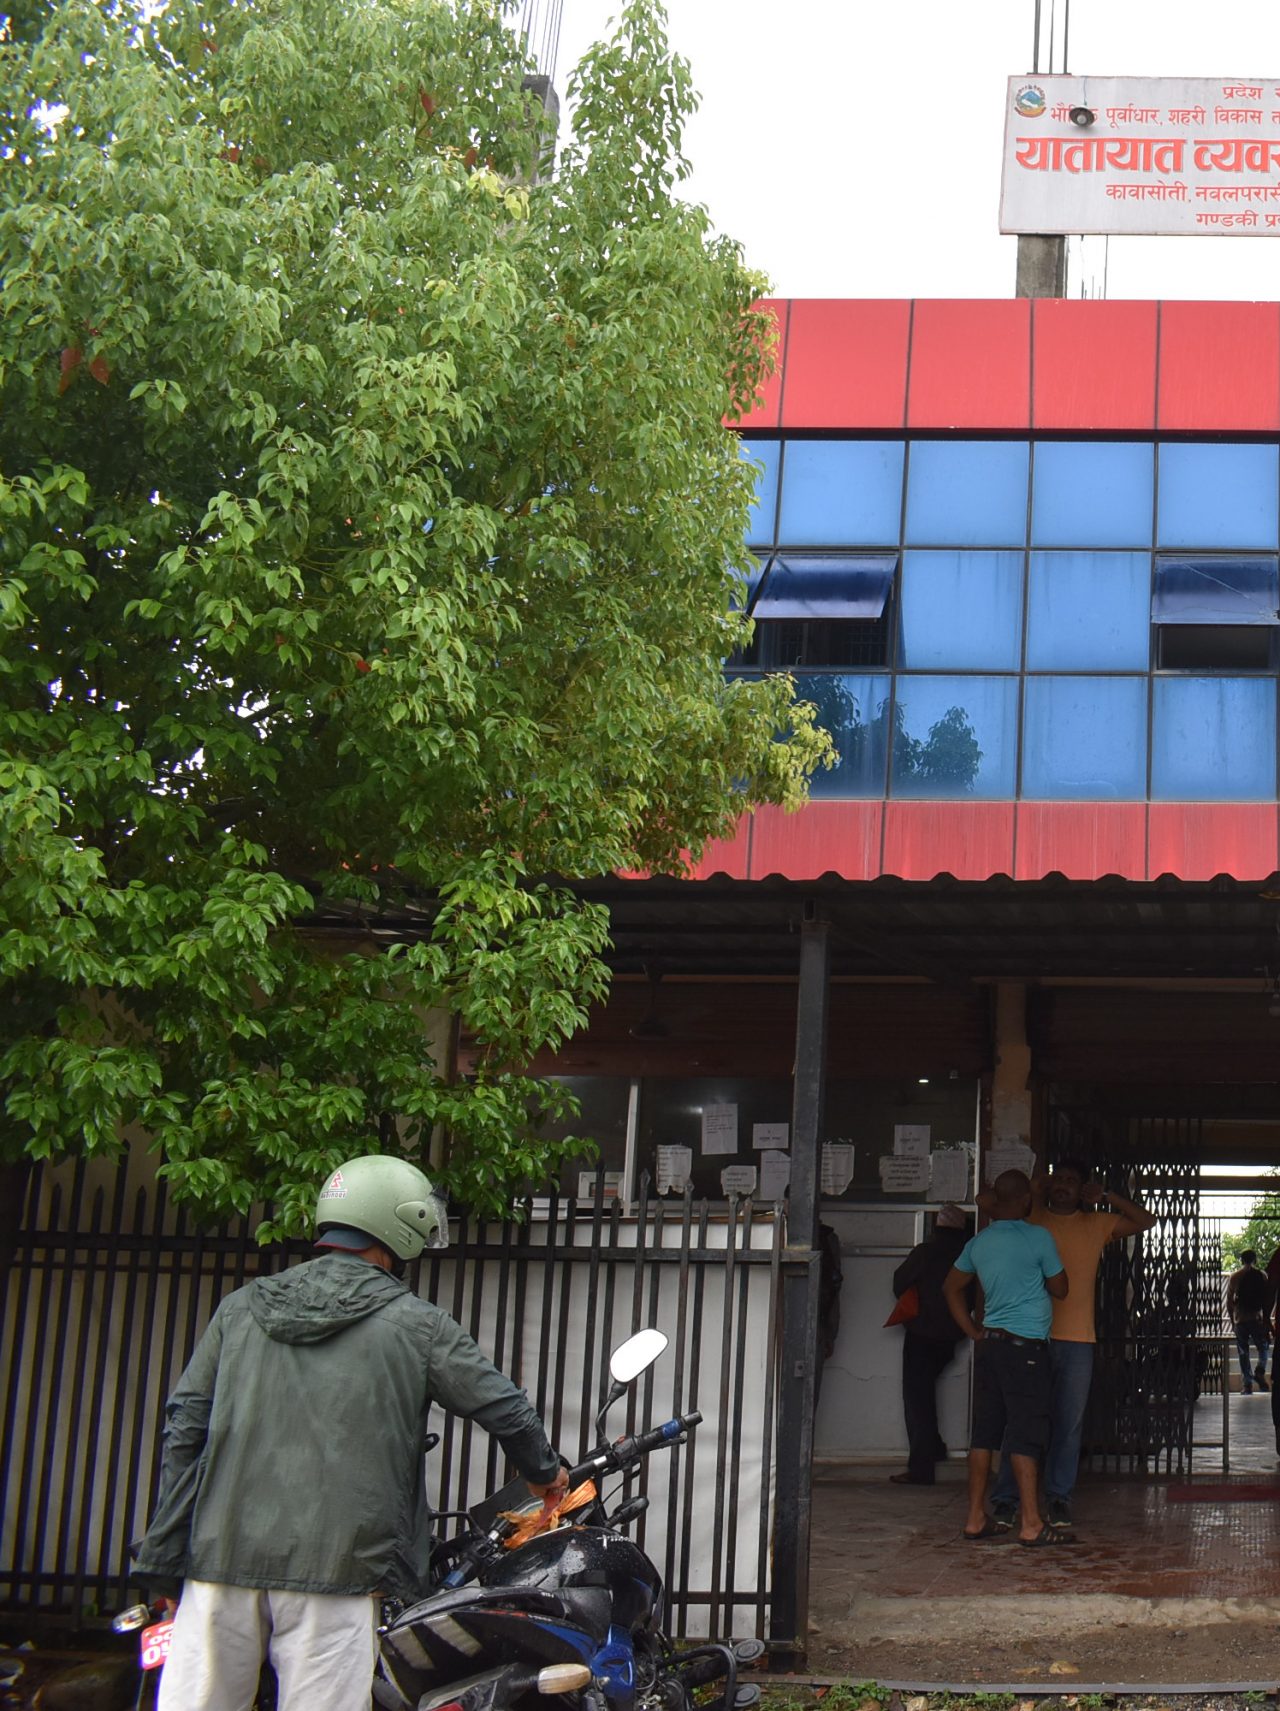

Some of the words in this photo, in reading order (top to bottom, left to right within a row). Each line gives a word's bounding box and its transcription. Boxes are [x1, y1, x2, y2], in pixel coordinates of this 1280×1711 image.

[1222, 83, 1263, 100] प्रदेश
[1106, 103, 1163, 128] पूर्वाधार,
[1168, 105, 1206, 125] शहरी
[1214, 106, 1263, 125] विकास
[1016, 137, 1187, 174] यातायात
[1196, 210, 1257, 227] गण्डकी
